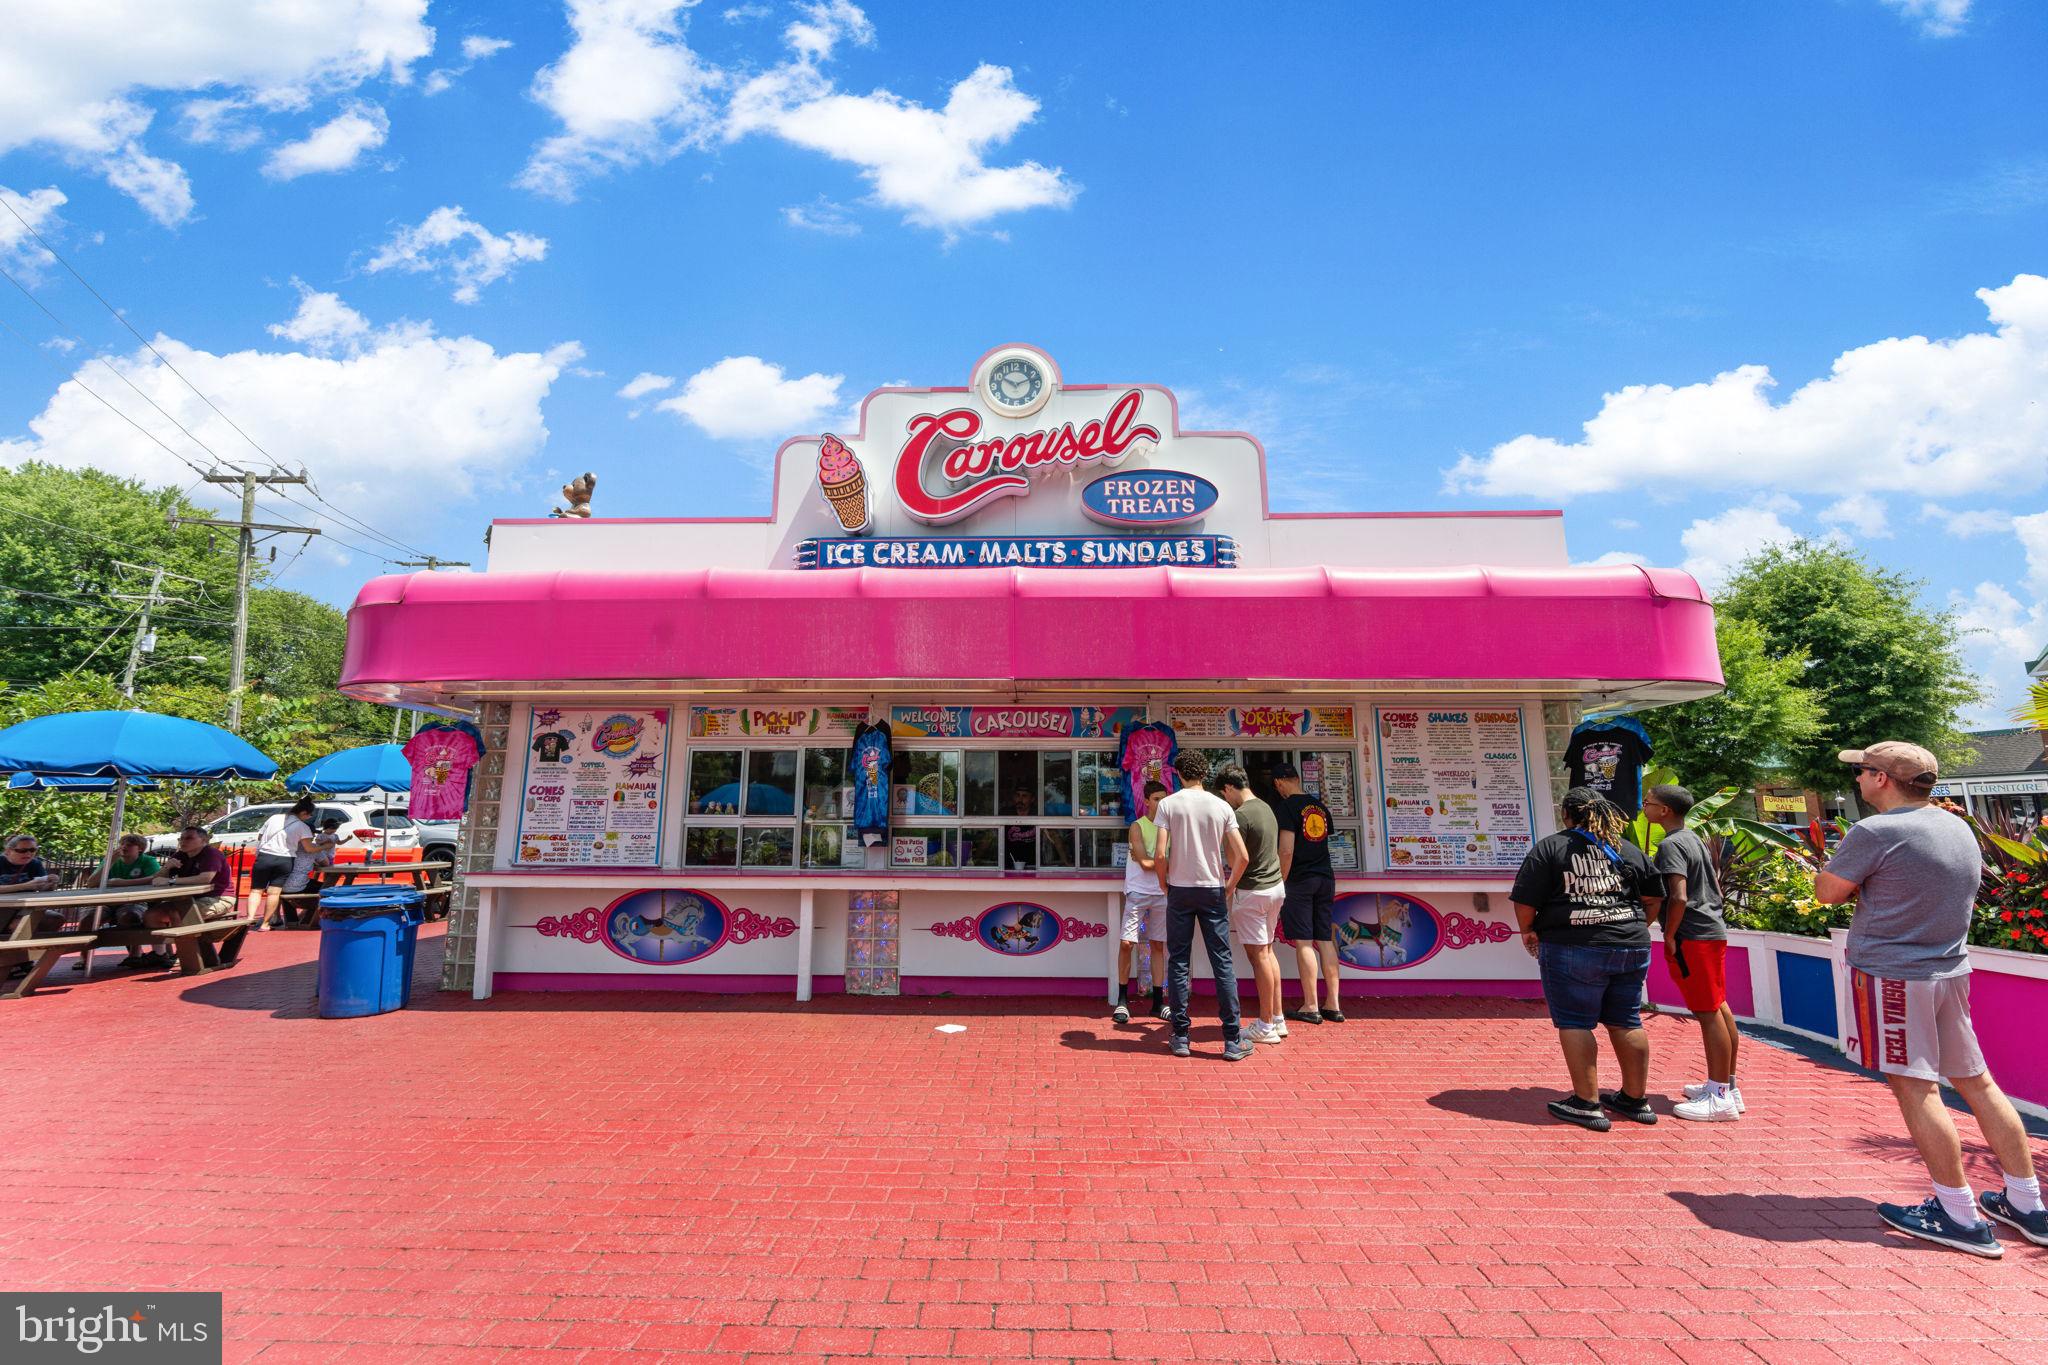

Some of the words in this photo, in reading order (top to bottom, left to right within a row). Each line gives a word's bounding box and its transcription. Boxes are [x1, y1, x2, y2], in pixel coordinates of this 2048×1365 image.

[1003, 365, 1009, 373] 11
[1010, 362, 1020, 371] 12
[1024, 364, 1027, 372] 1
[990, 382, 997, 390] 9
[1035, 380, 1041, 388] 3
[995, 391, 1001, 400] 8
[1032, 390, 1037, 398] 4
[895, 389, 1161, 520] Carousel
[1104, 479, 1196, 496] FROZEN
[1107, 497, 1195, 514] TREATS
[826, 543, 865, 565] ICE
[873, 543, 966, 565] CREAM
[979, 542, 1067, 563] MALTS
[1082, 540, 1207, 563] SUNDAES
[753, 710, 807, 727] PICK-UP
[900, 710, 956, 722] WELCOME
[1245, 711, 1294, 725] ORDER
[1383, 712, 1419, 722] CONES
[1428, 712, 1468, 723] SHAKES
[1474, 712, 1519, 723] SUNDAES
[975, 711, 1068, 734] CAROUSEL
[767, 725, 791, 735] HERE
[926, 724, 938, 733] TO
[940, 723, 956, 733] THE
[1260, 725, 1282, 735] HERE
[529, 785, 564, 796] CONES
[616, 782, 656, 791] HAWAIIAN
[1930, 786, 1951, 796] SSES
[1973, 783, 2045, 793] FURNITURE
[543, 795, 561, 803] CUPS
[644, 791, 656, 799] ICE
[1764, 796, 1804, 804] FURNITURE
[1586, 844, 1607, 860] The
[1571, 852, 1612, 877] Other
[1563, 870, 1623, 895] People's
[1570, 911, 1635, 926] ENTERTAINMENT
[1881, 976, 1906, 1024] RGINIA
[1884, 1028, 1909, 1066] TECH
